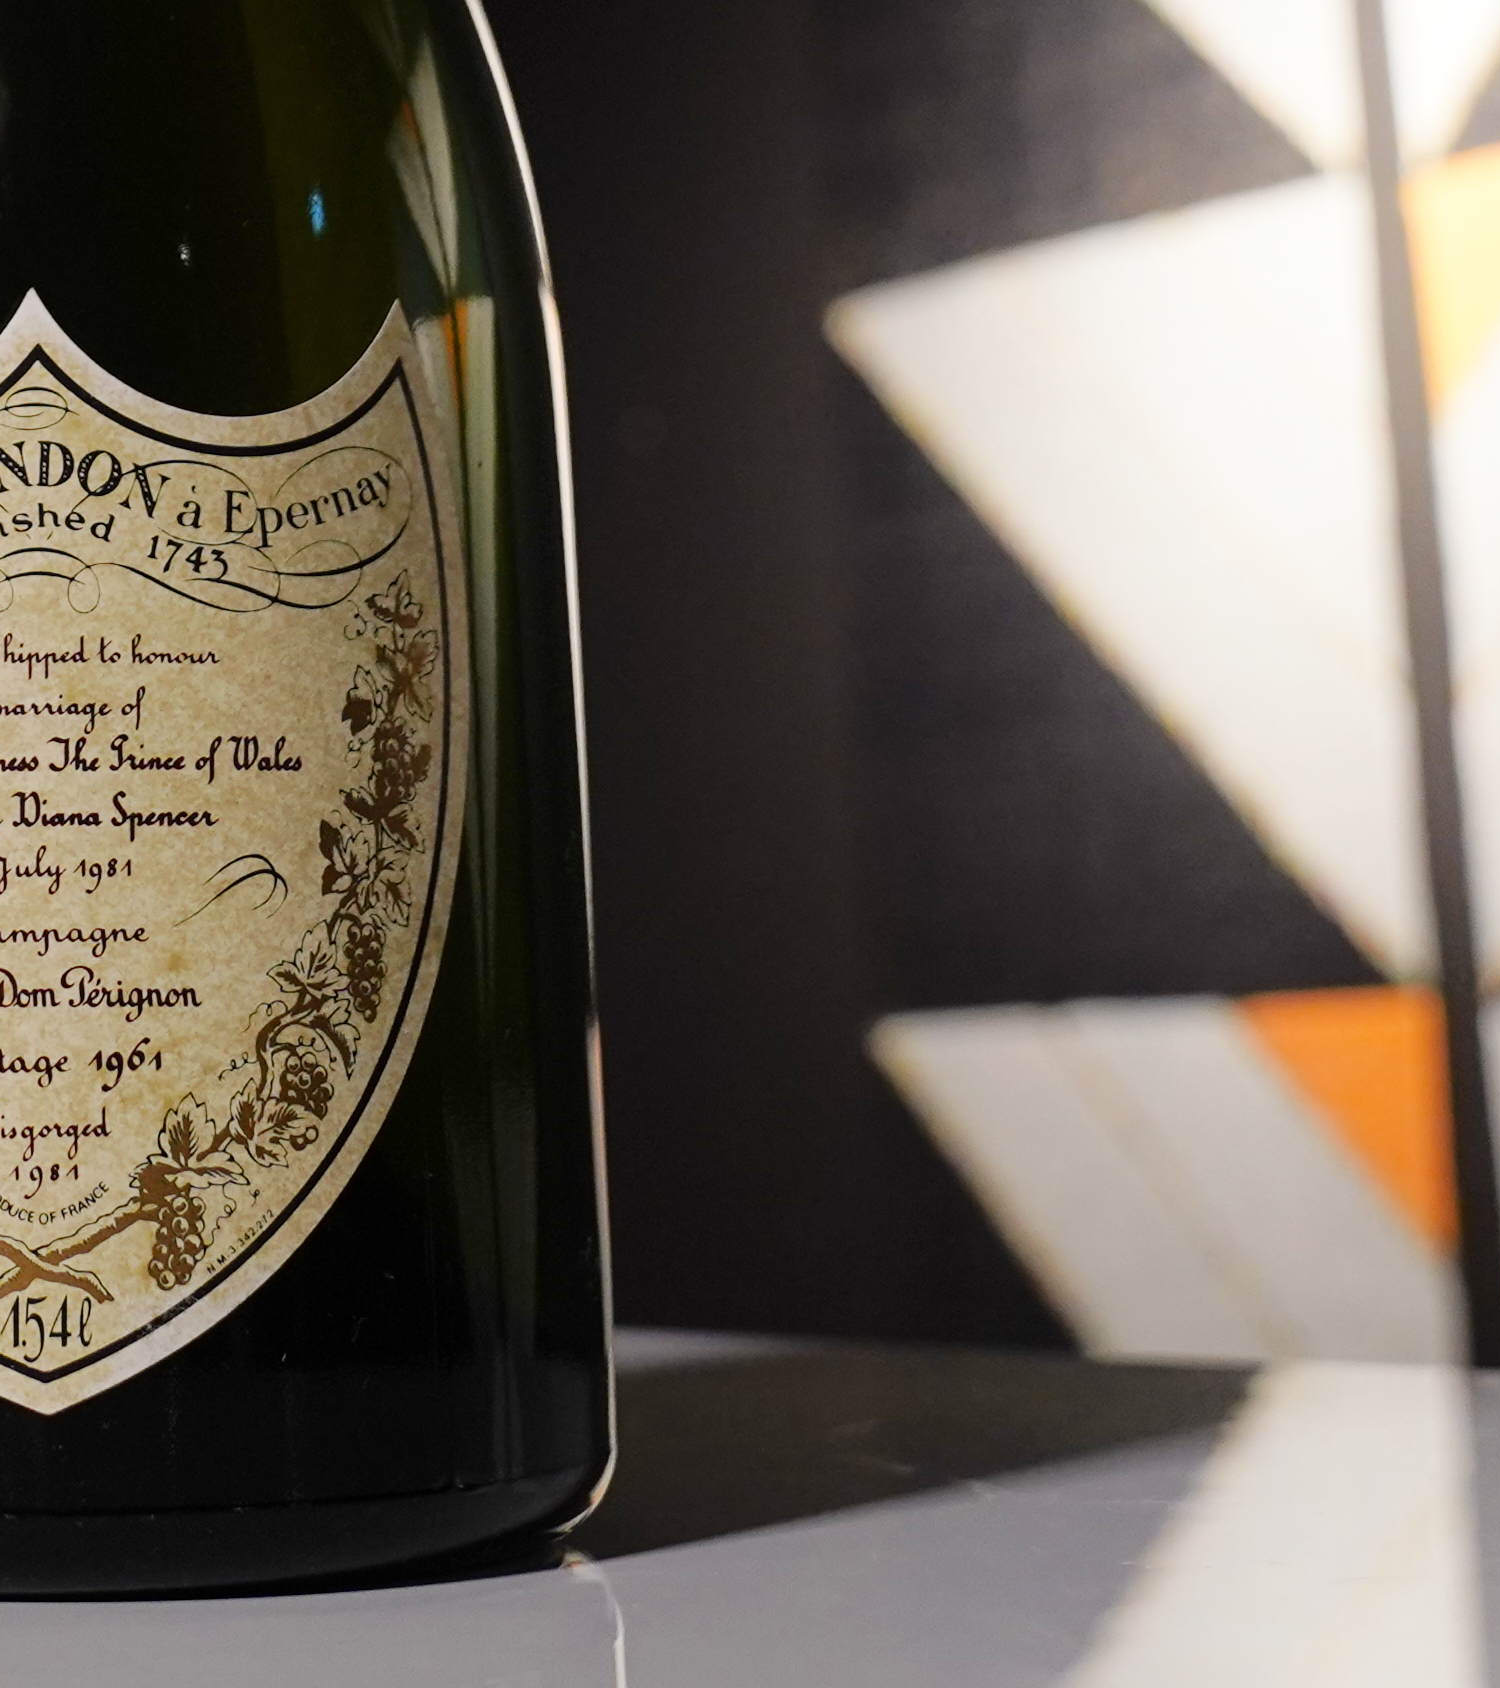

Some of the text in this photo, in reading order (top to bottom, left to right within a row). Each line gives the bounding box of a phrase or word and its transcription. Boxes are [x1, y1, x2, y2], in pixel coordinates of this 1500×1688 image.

[176, 485, 202, 529] à
[223, 463, 392, 549] Epernay
[148, 535, 228, 579] 1743
[99, 635, 121, 665] to
[131, 633, 220, 665] honour
[121, 686, 146, 728] of
[48, 736, 100, 772] The
[109, 734, 185, 771] Prince
[195, 736, 223, 783] of
[228, 736, 302, 772] Wales
[12, 792, 102, 829] Diana
[111, 791, 218, 842] Spencer
[74, 858, 131, 894] 1981
[60, 965, 203, 1022] Pérignon
[88, 1037, 163, 1092] 1961
[8, 1163, 79, 1200] 1981
[38, 1211, 58, 1225] OF
[60, 1181, 110, 1220] FRANCE
